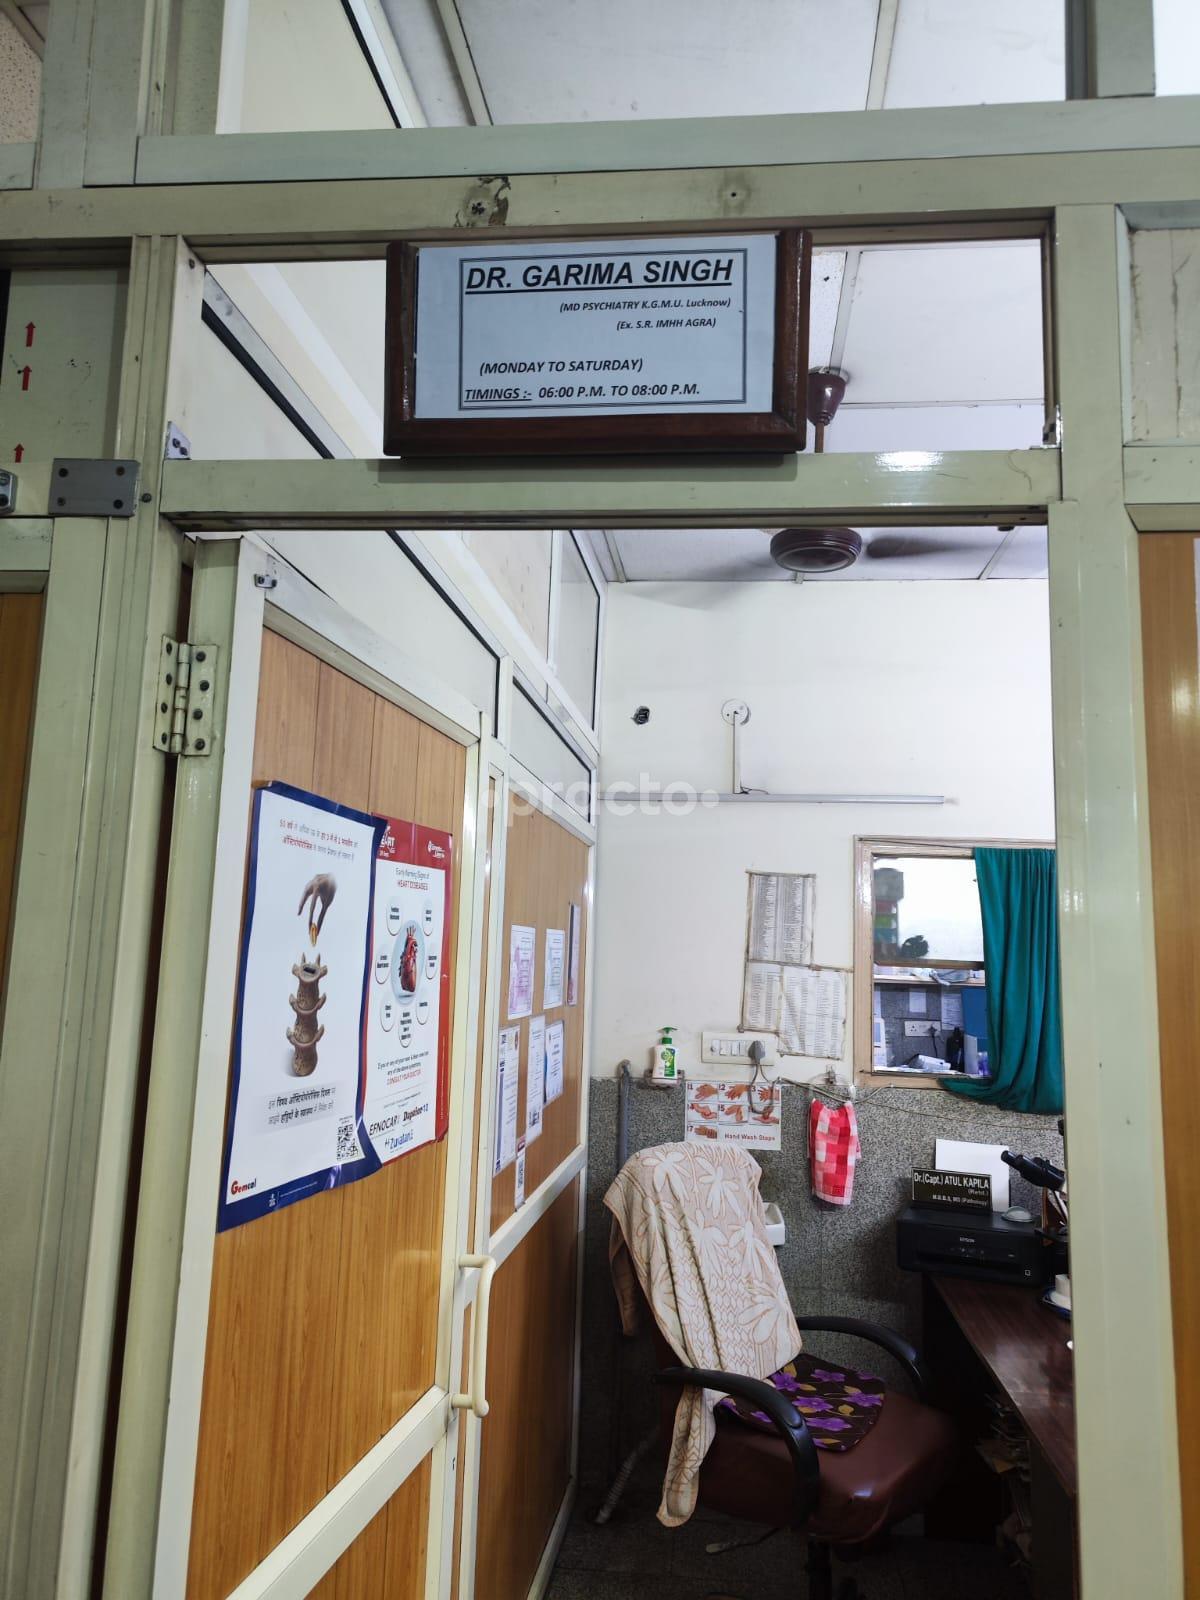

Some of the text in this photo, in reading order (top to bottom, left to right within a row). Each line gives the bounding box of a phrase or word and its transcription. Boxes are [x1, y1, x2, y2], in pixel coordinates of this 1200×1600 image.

[466, 259, 733, 289] DR. GARIMA SINGH
[560, 298, 731, 313] (MD PSYCHIATRY K.G.M.U. Lucknow)
[616, 317, 716, 331] (Ex. S.R. IMHH AGRA)
[480, 358, 643, 376] (MONDAY TO SATURDAY)
[464, 388, 521, 400] TIMINGS
[538, 386, 574, 398] 06:00
[577, 385, 606, 397] P.M.
[611, 385, 628, 396] TO
[631, 384, 667, 396] 08:00
[671, 383, 700, 395] P.M.
[944, 1175, 963, 1187] ATUL
[962, 1177, 989, 1189] KAPILA
